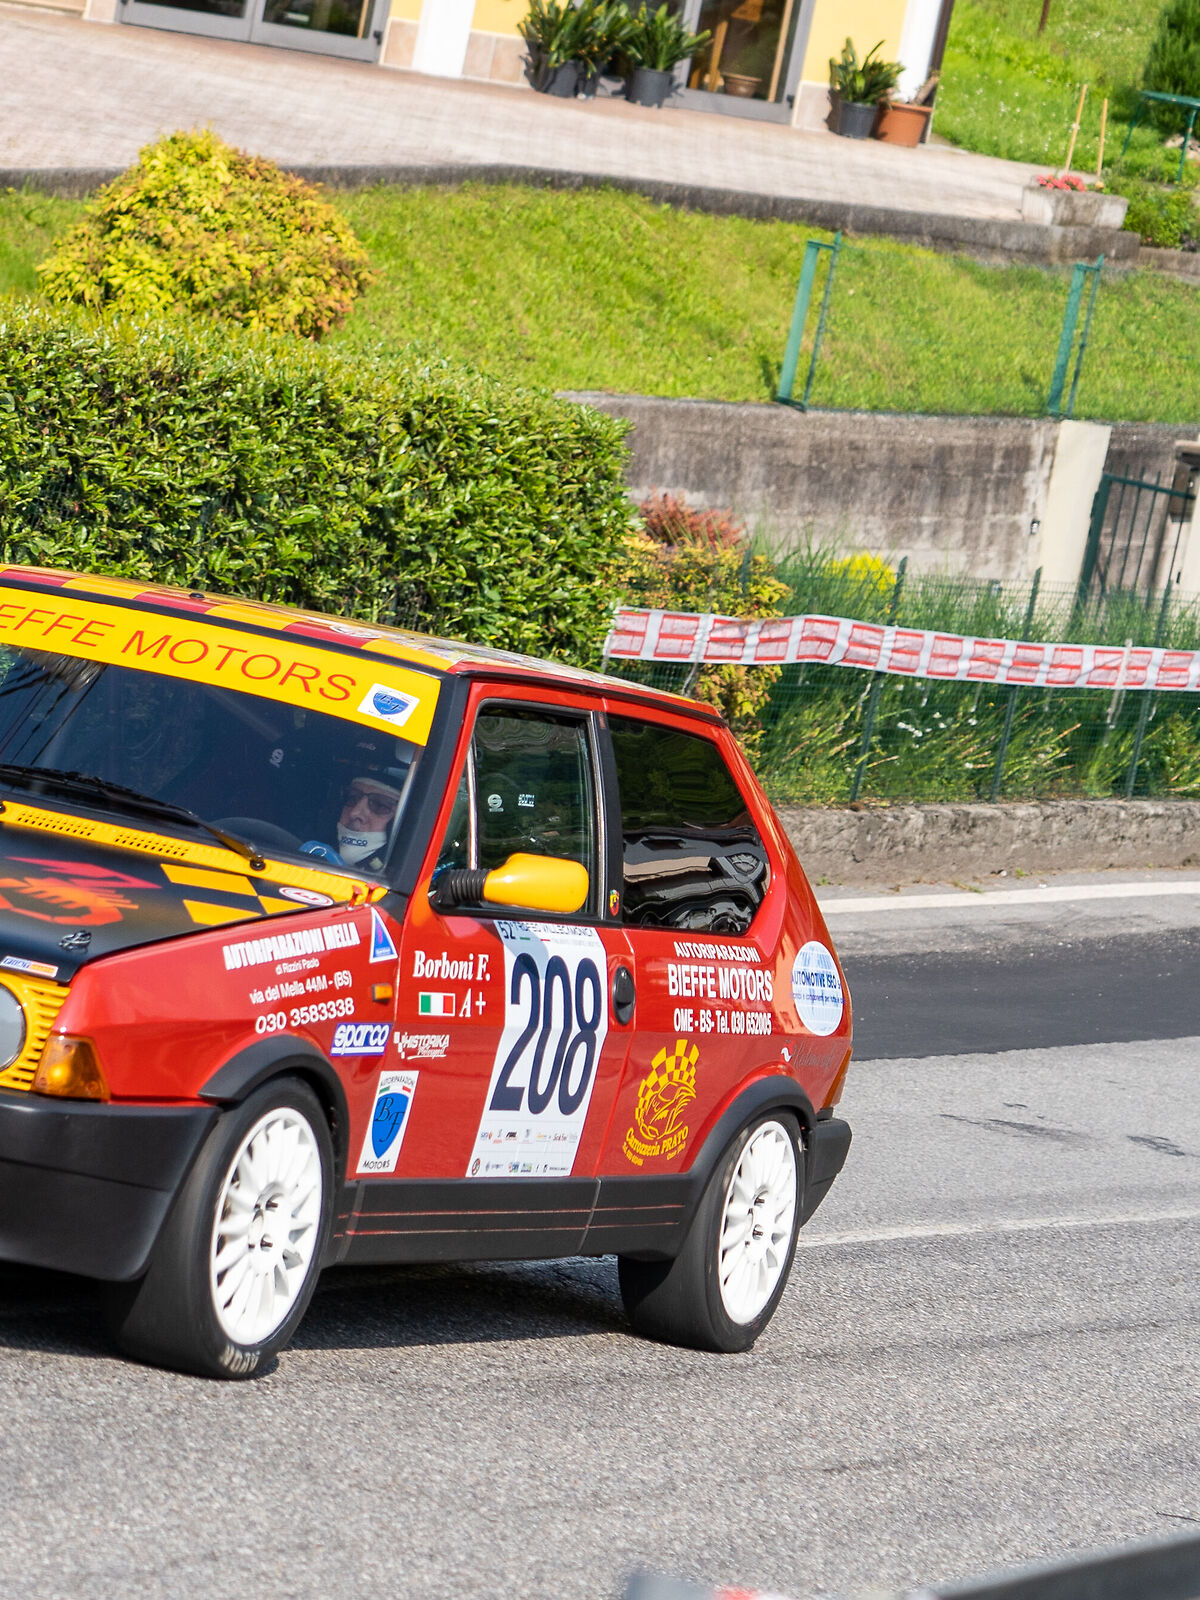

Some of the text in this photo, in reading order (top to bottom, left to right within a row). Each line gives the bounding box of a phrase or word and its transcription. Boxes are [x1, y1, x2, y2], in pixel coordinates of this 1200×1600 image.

[121, 629, 357, 702] MOTORS
[223, 922, 360, 970] AUTORIPARAZIONI MELLA
[673, 941, 761, 963] AUTORIPARAZIONI
[412, 950, 490, 981] Borboni F.
[249, 989, 264, 1004] via
[265, 987, 280, 1001] del
[281, 980, 305, 999] Mella
[334, 970, 352, 990] (BS)
[667, 964, 773, 1002] BIEFFE MOTORS
[255, 997, 354, 1034] 030 3583338
[674, 1008, 693, 1032] OME
[716, 1010, 729, 1034] Tel.
[731, 1011, 745, 1034] 030
[746, 1012, 772, 1036] 652005
[334, 1024, 389, 1053] sparco
[490, 952, 602, 1116] 208
[661, 1126, 688, 1154] PRATO
[362, 1159, 390, 1170] MOTORS
